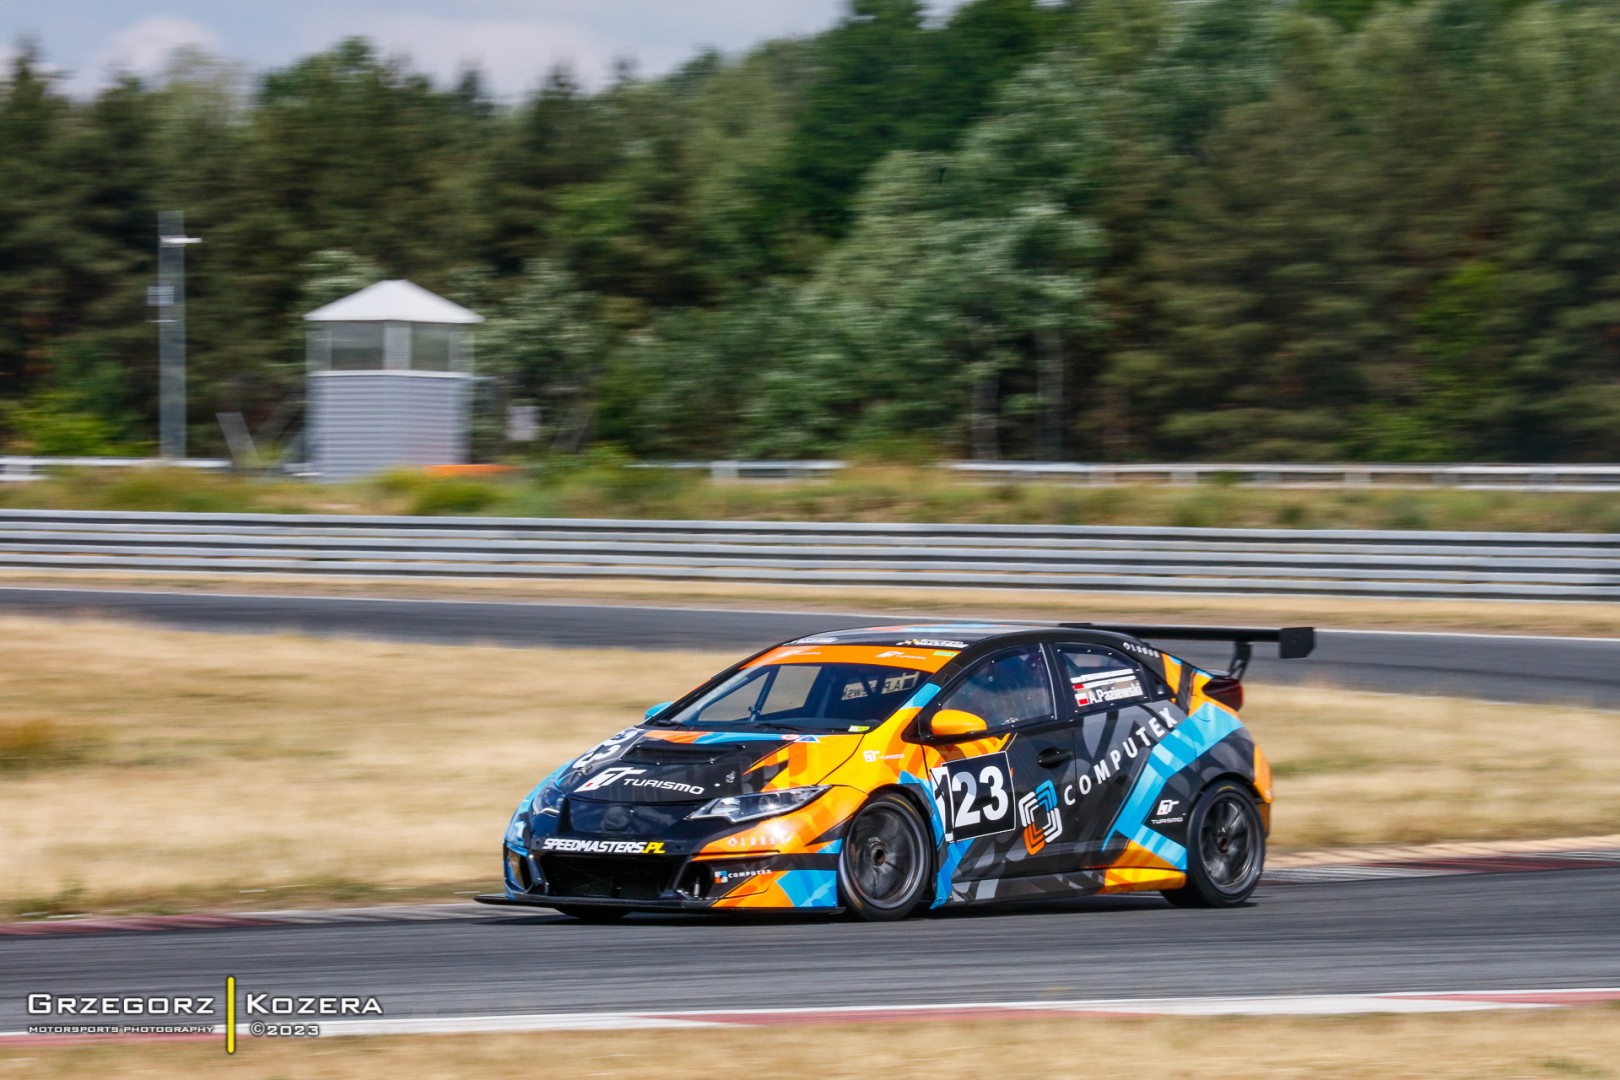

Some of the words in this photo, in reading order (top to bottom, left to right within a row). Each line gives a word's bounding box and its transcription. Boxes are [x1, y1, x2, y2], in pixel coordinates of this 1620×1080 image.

[1064, 707, 1178, 806] COMPUTEX
[623, 778, 705, 795] TURISMO
[542, 838, 666, 854] SPEEDMASTERS.PL
[728, 869, 772, 878] COMPUTEX
